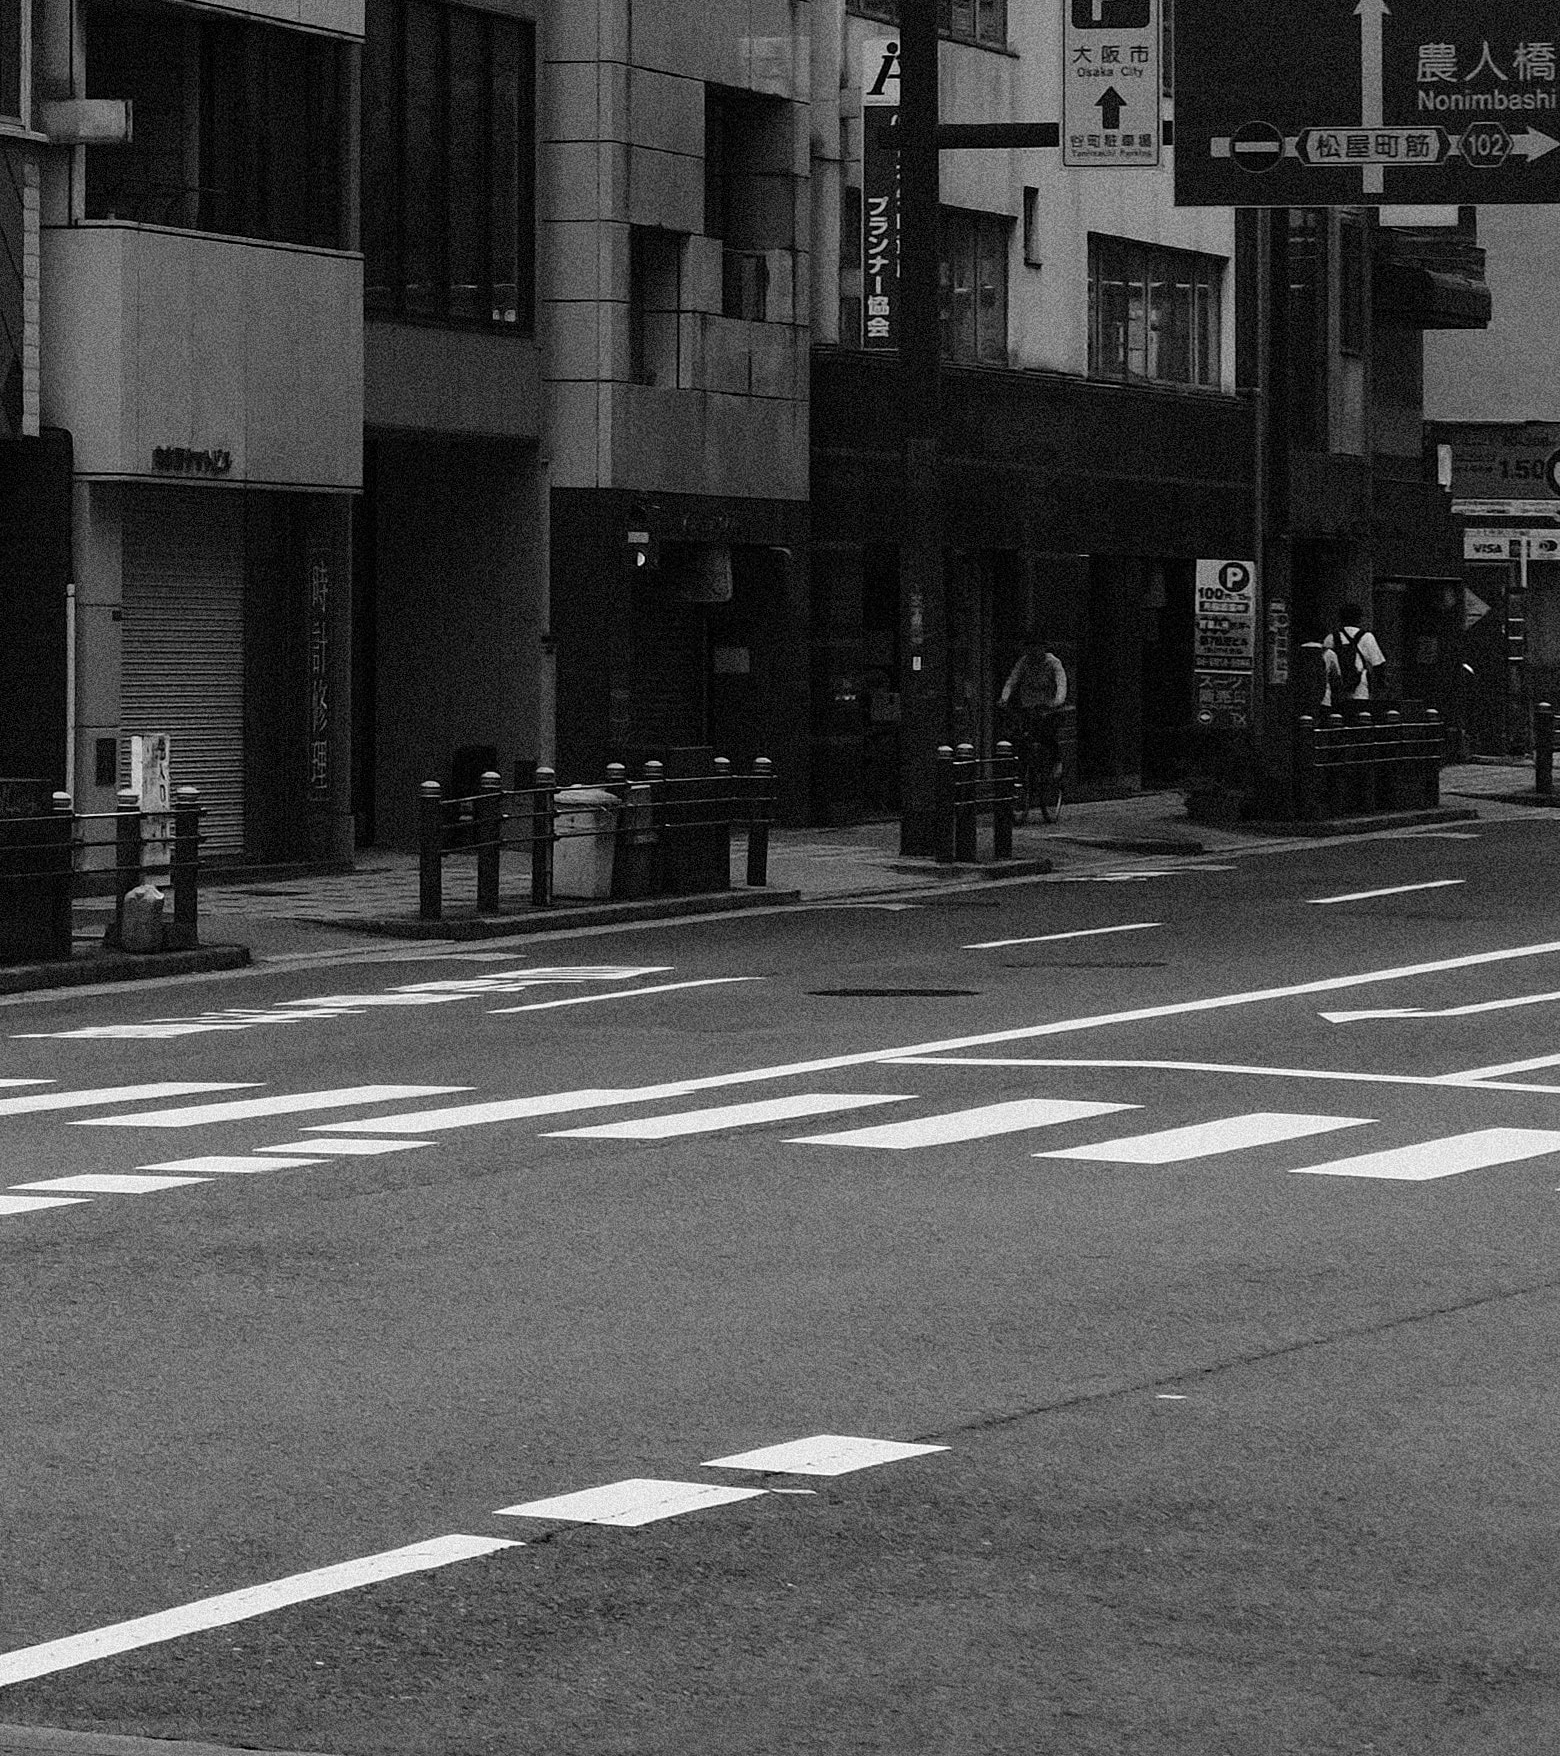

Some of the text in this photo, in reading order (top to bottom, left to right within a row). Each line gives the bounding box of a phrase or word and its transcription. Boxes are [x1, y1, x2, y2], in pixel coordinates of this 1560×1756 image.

[1072, 45, 1150, 64] 大阪市
[1416, 41, 1557, 84] 農人橋
[1077, 67, 1144, 79] Osaka City
[1418, 90, 1558, 112] Nonimbashi
[1315, 133, 1431, 159] 松屋町筋
[1467, 134, 1503, 156] 102
[868, 197, 890, 338] プランナー協会
[1472, 543, 1503, 554] VISA
[1226, 566, 1244, 590] P
